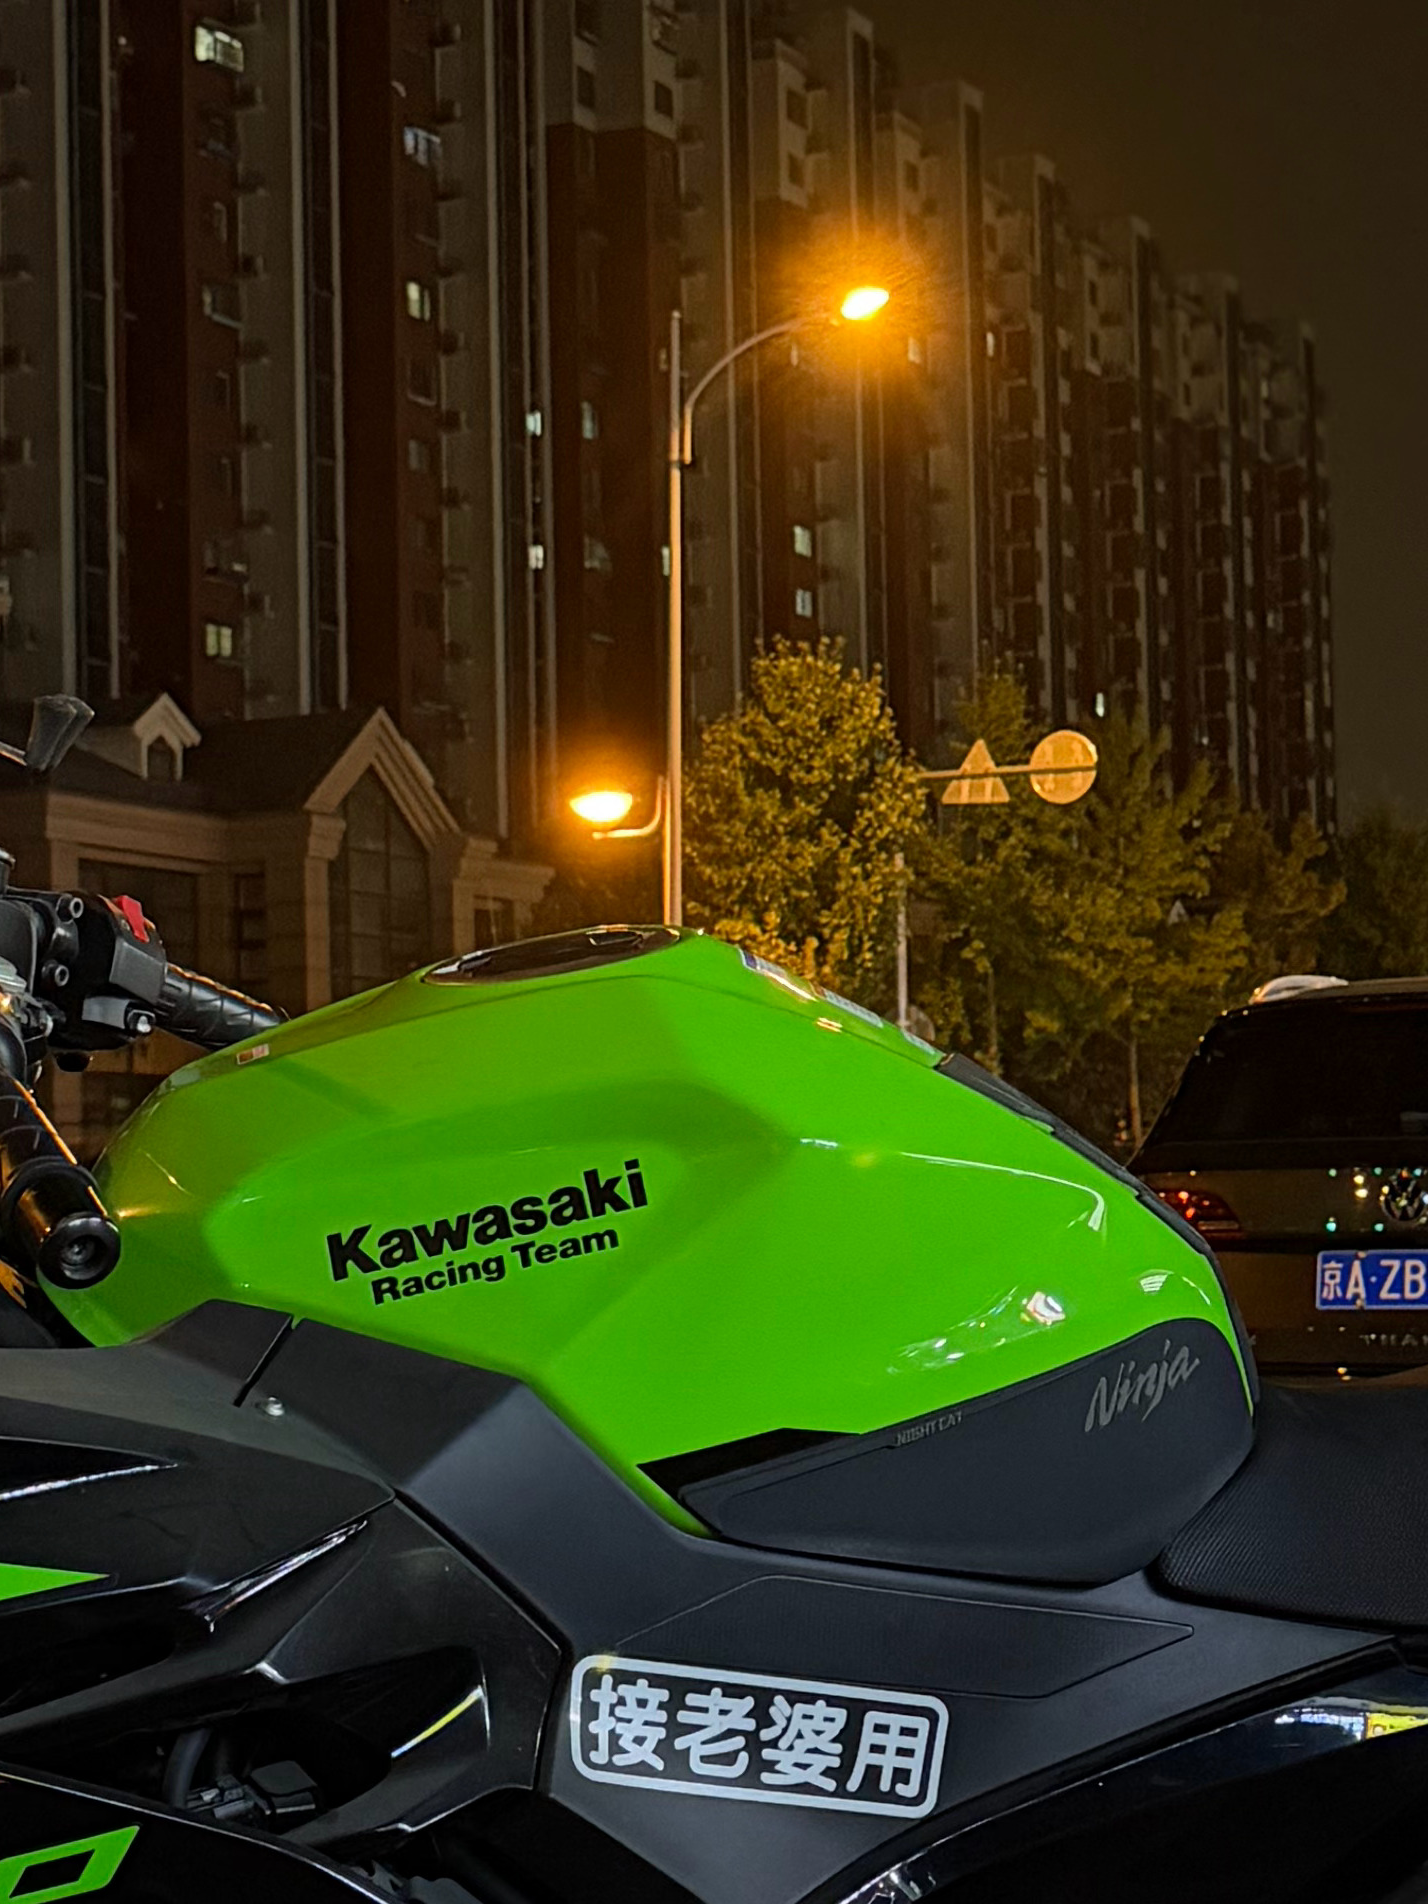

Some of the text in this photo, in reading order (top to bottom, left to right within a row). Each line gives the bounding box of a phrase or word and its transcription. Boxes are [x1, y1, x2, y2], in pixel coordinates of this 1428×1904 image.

[327, 1159, 648, 1281] Kawasaki
[372, 1228, 618, 1304] Racing Team
[1085, 1339, 1200, 1432] Ninja
[588, 1674, 930, 1798] 接老婆用
